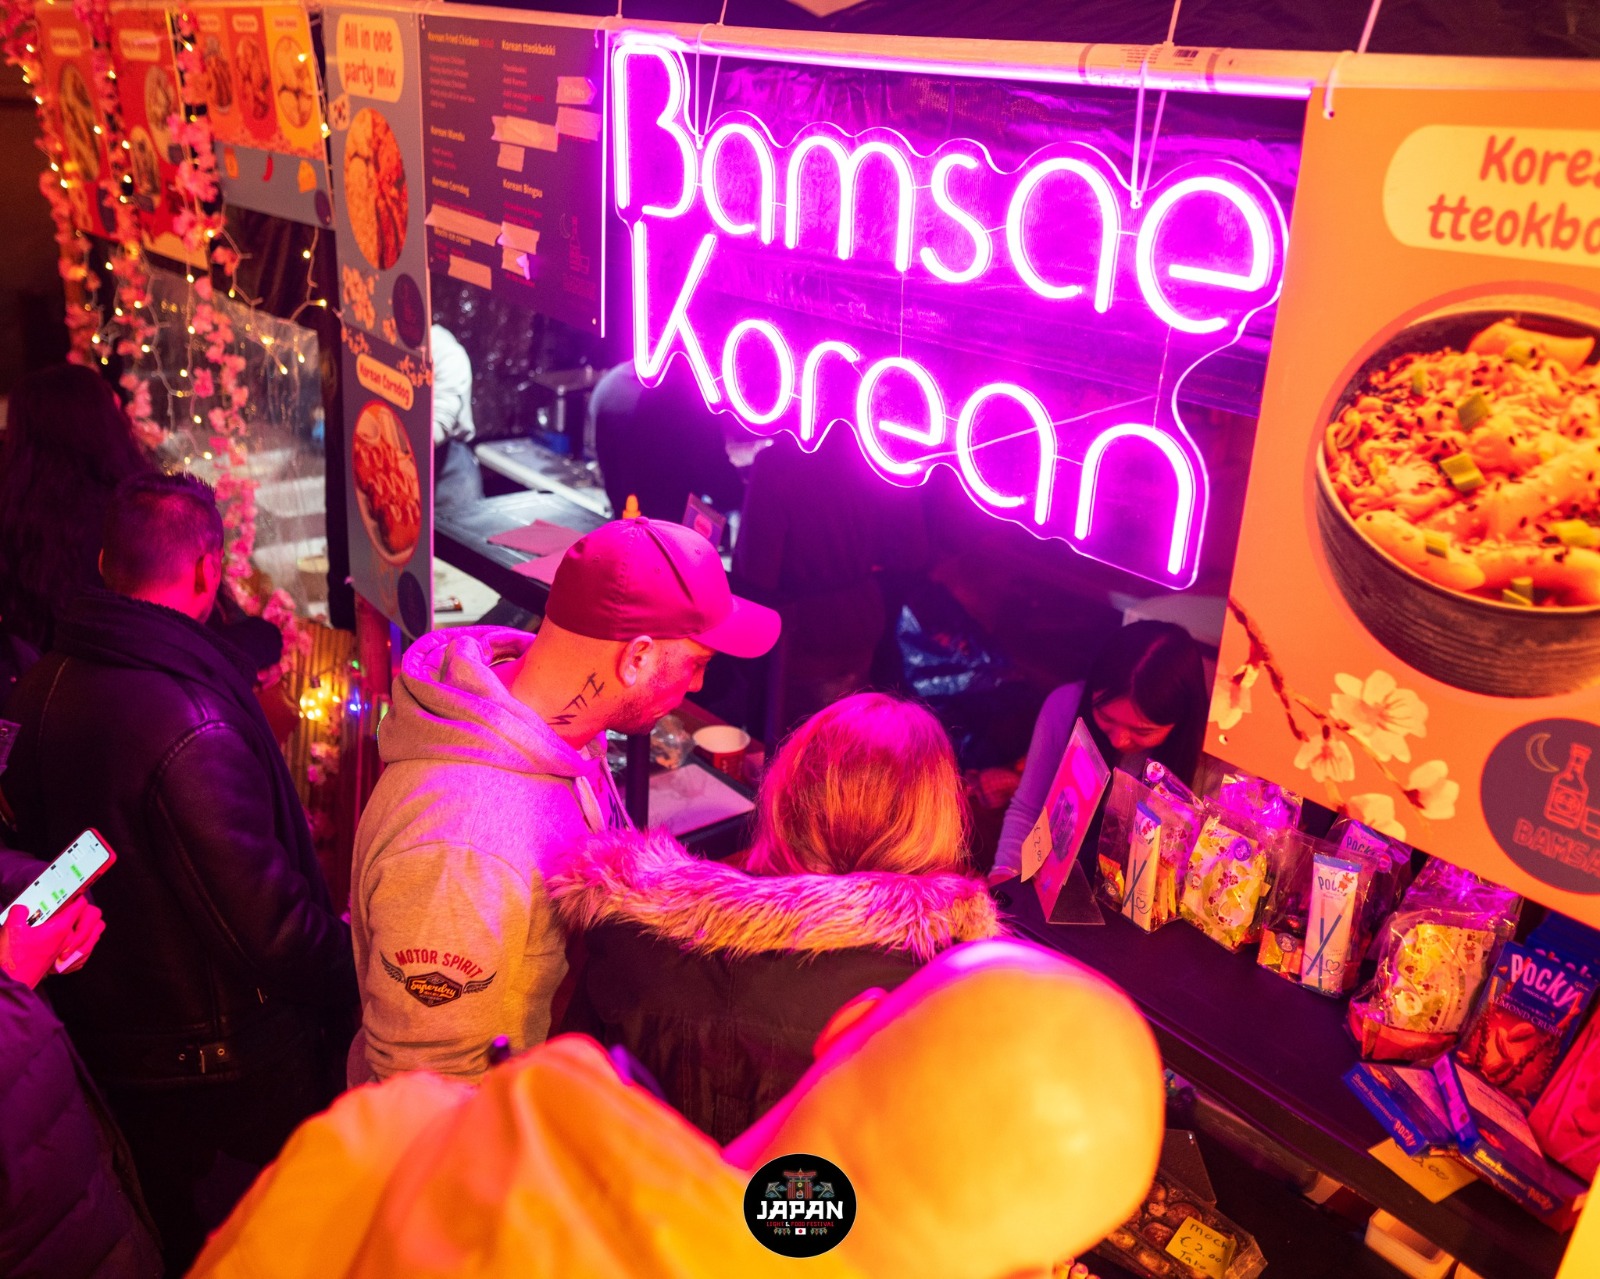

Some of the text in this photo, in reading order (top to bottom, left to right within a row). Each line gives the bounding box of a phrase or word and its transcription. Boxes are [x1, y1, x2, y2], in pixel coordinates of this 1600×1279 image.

[344, 22, 393, 53] All in one
[502, 39, 523, 52] Korean
[344, 58, 396, 95] party mix
[612, 43, 1275, 334] Bamsae
[1428, 193, 1600, 255] tteokbo
[359, 362, 411, 406] Korean Corndog
[633, 221, 1196, 576] Korean
[395, 949, 483, 979] MOTOR SPIRIT
[410, 979, 457, 999] Superdry
